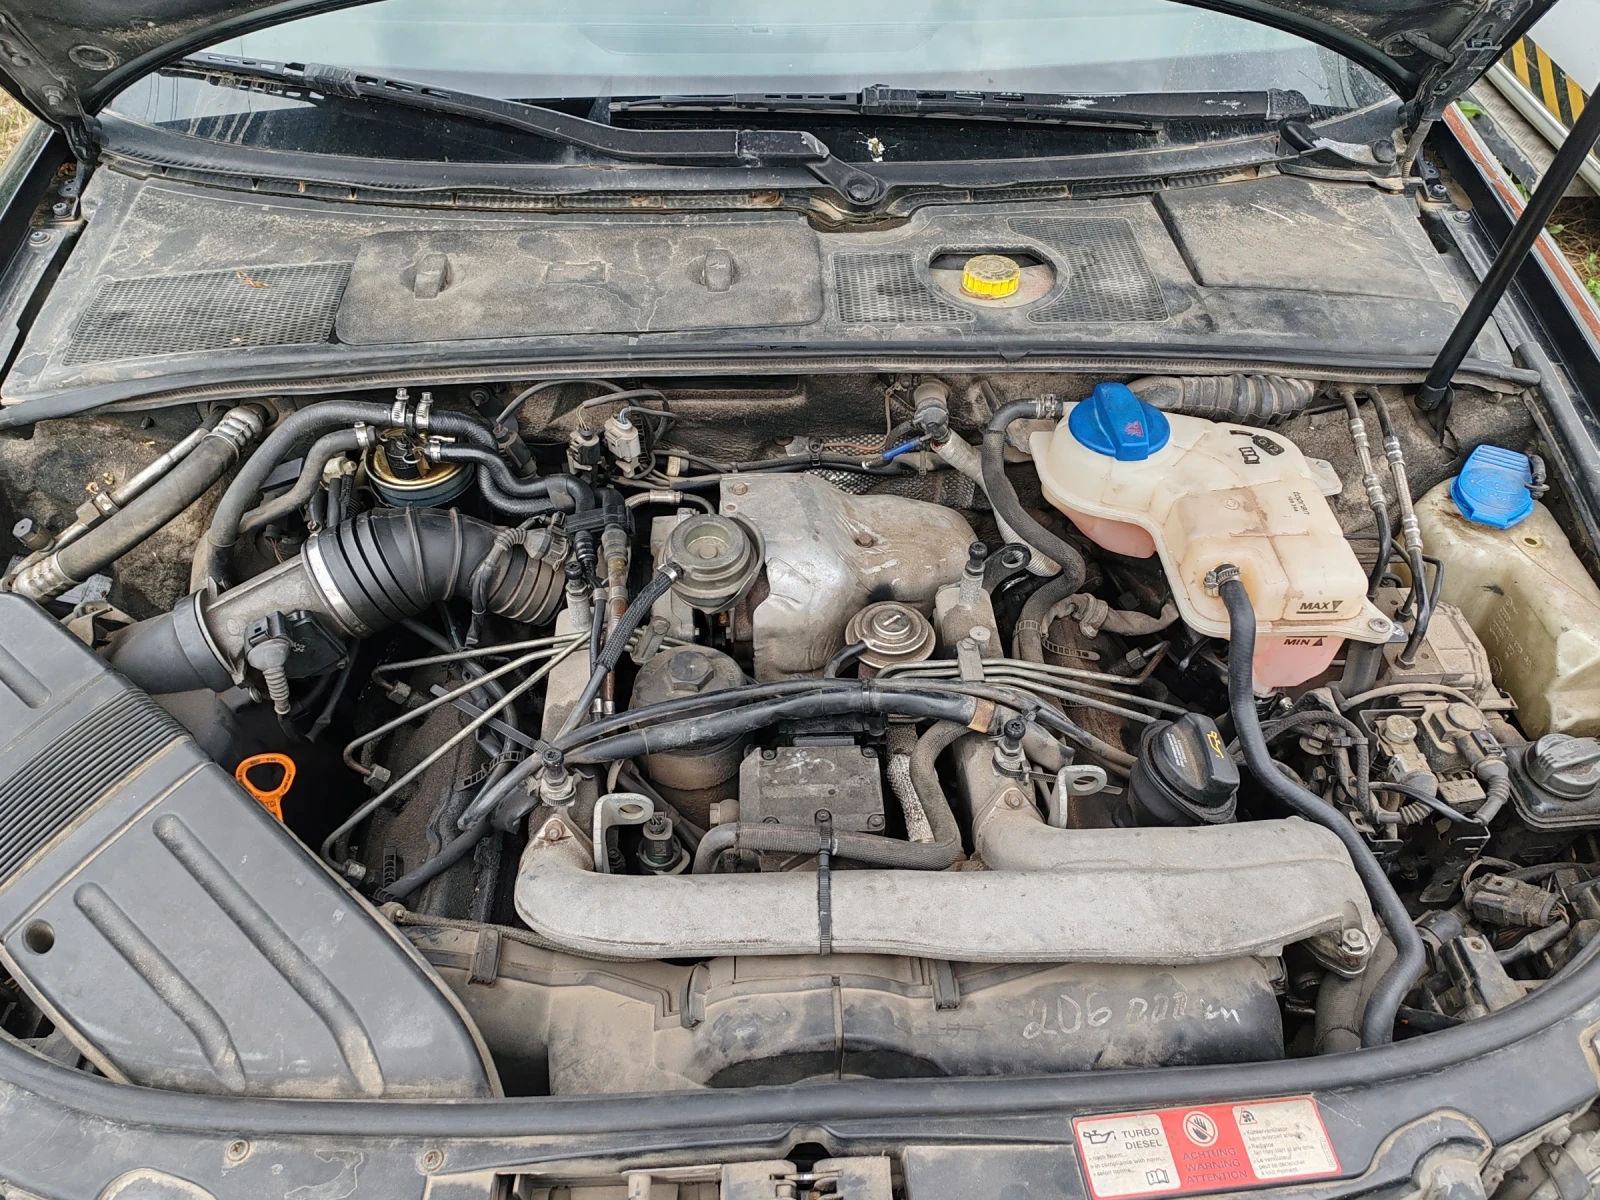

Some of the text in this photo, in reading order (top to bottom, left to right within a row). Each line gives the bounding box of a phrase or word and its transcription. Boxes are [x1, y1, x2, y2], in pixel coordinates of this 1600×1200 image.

[1299, 602, 1330, 610] MAX
[1283, 638, 1310, 646] MIN
[1121, 1127, 1160, 1139] TURBO
[1125, 1139, 1162, 1150] DIESEL
[1183, 1147, 1237, 1161] ACHTUNG
[1185, 1158, 1241, 1172] WARNING
[1187, 1169, 1249, 1184] ATTENTION
